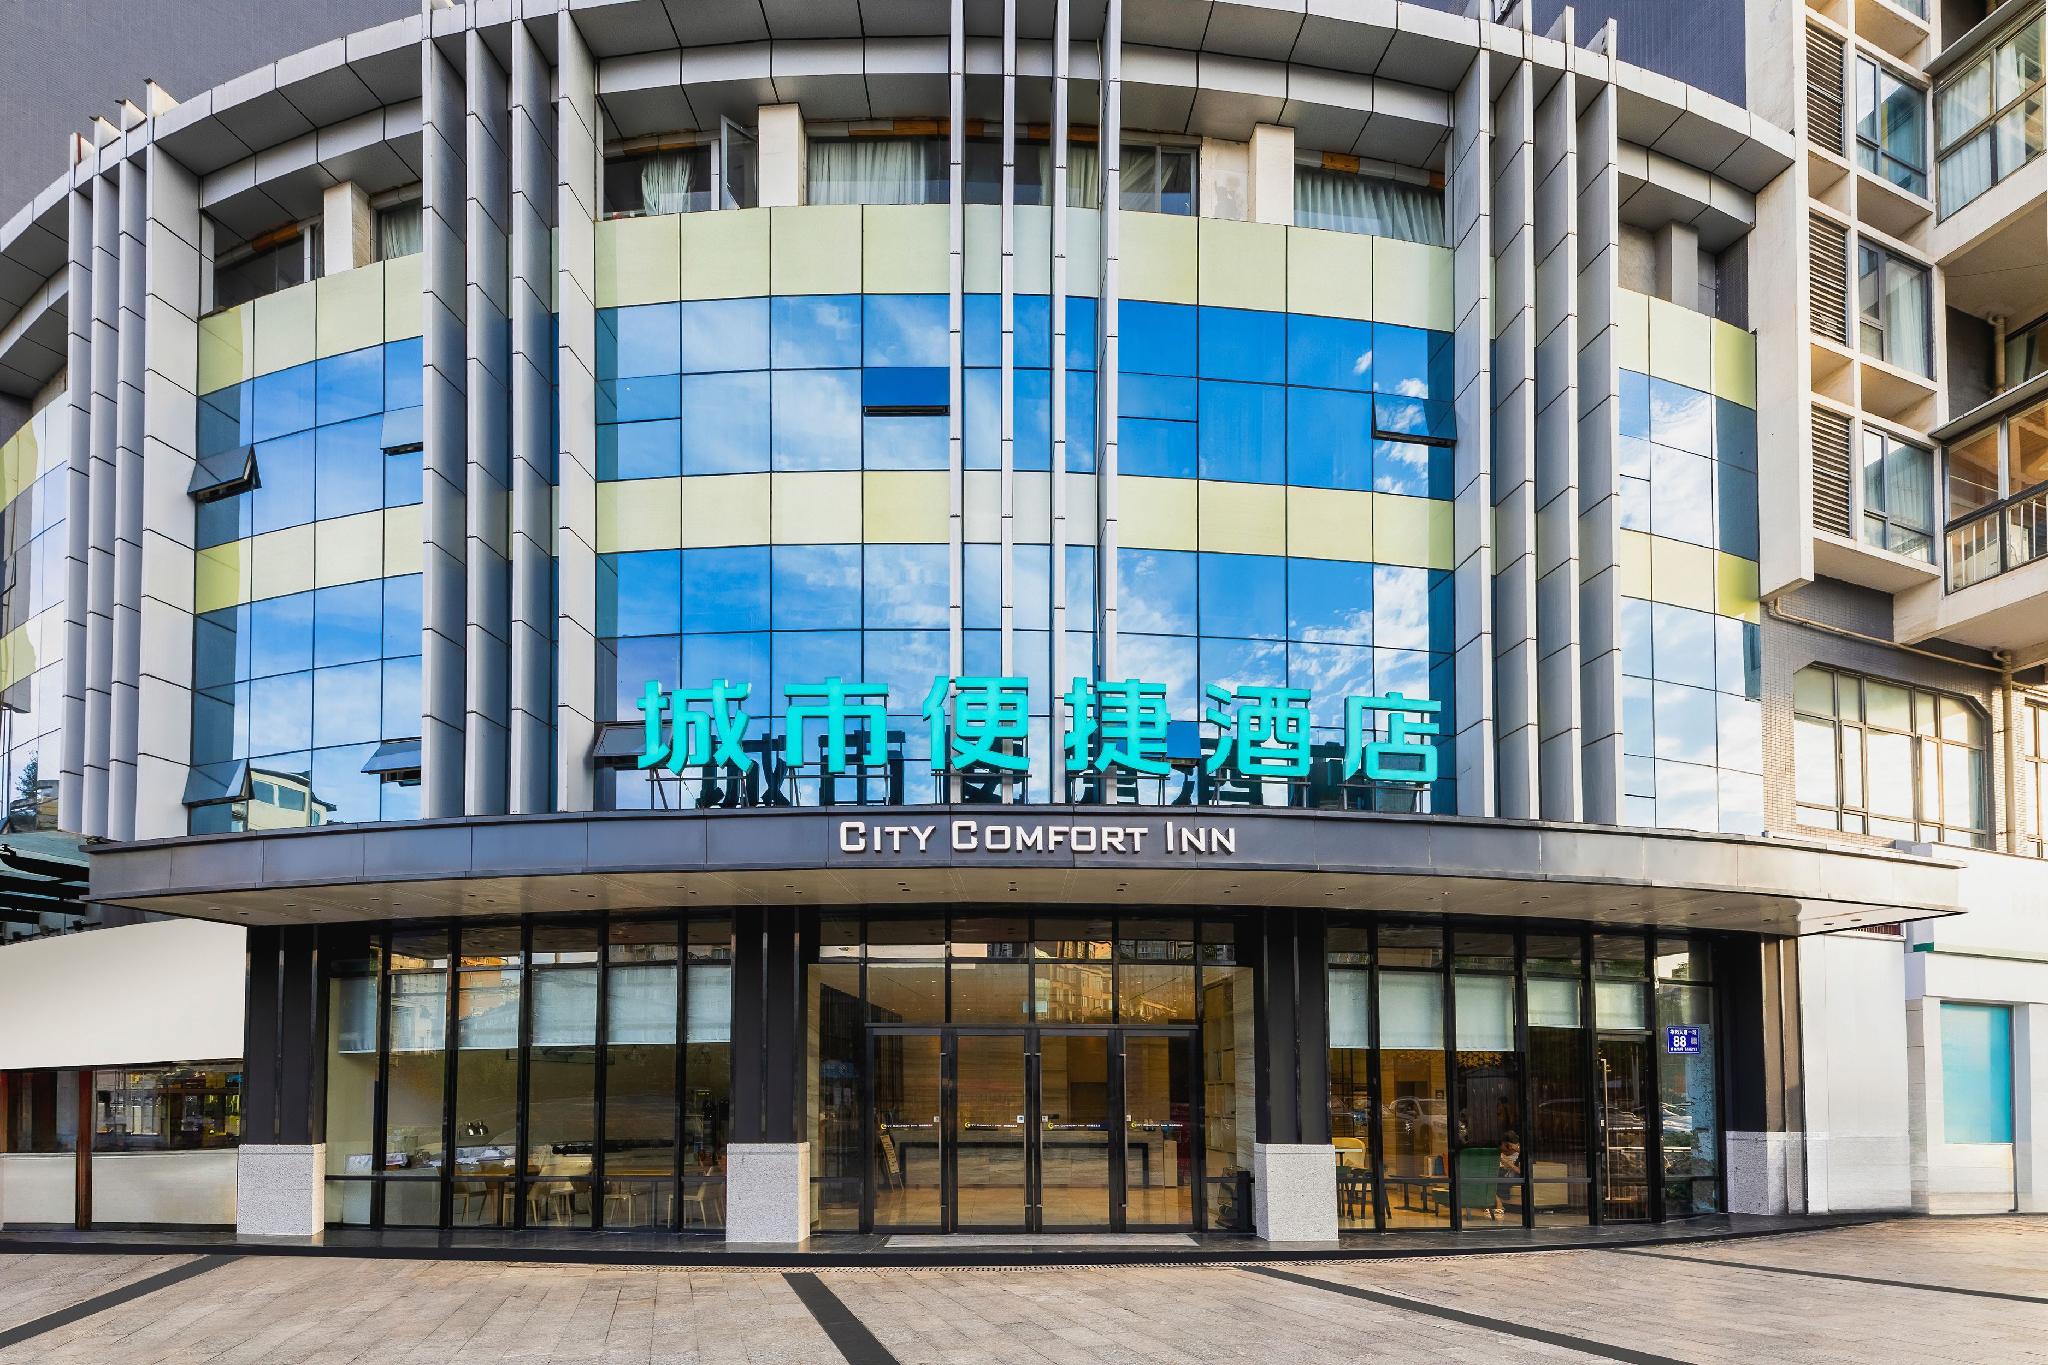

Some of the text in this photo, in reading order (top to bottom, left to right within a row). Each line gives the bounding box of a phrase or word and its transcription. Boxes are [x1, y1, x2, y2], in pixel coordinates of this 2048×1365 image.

[637, 676, 1441, 782] 城市便捷酒店
[839, 820, 1237, 853] CITY COMFORT INN
[1673, 1035, 1686, 1047] 88
